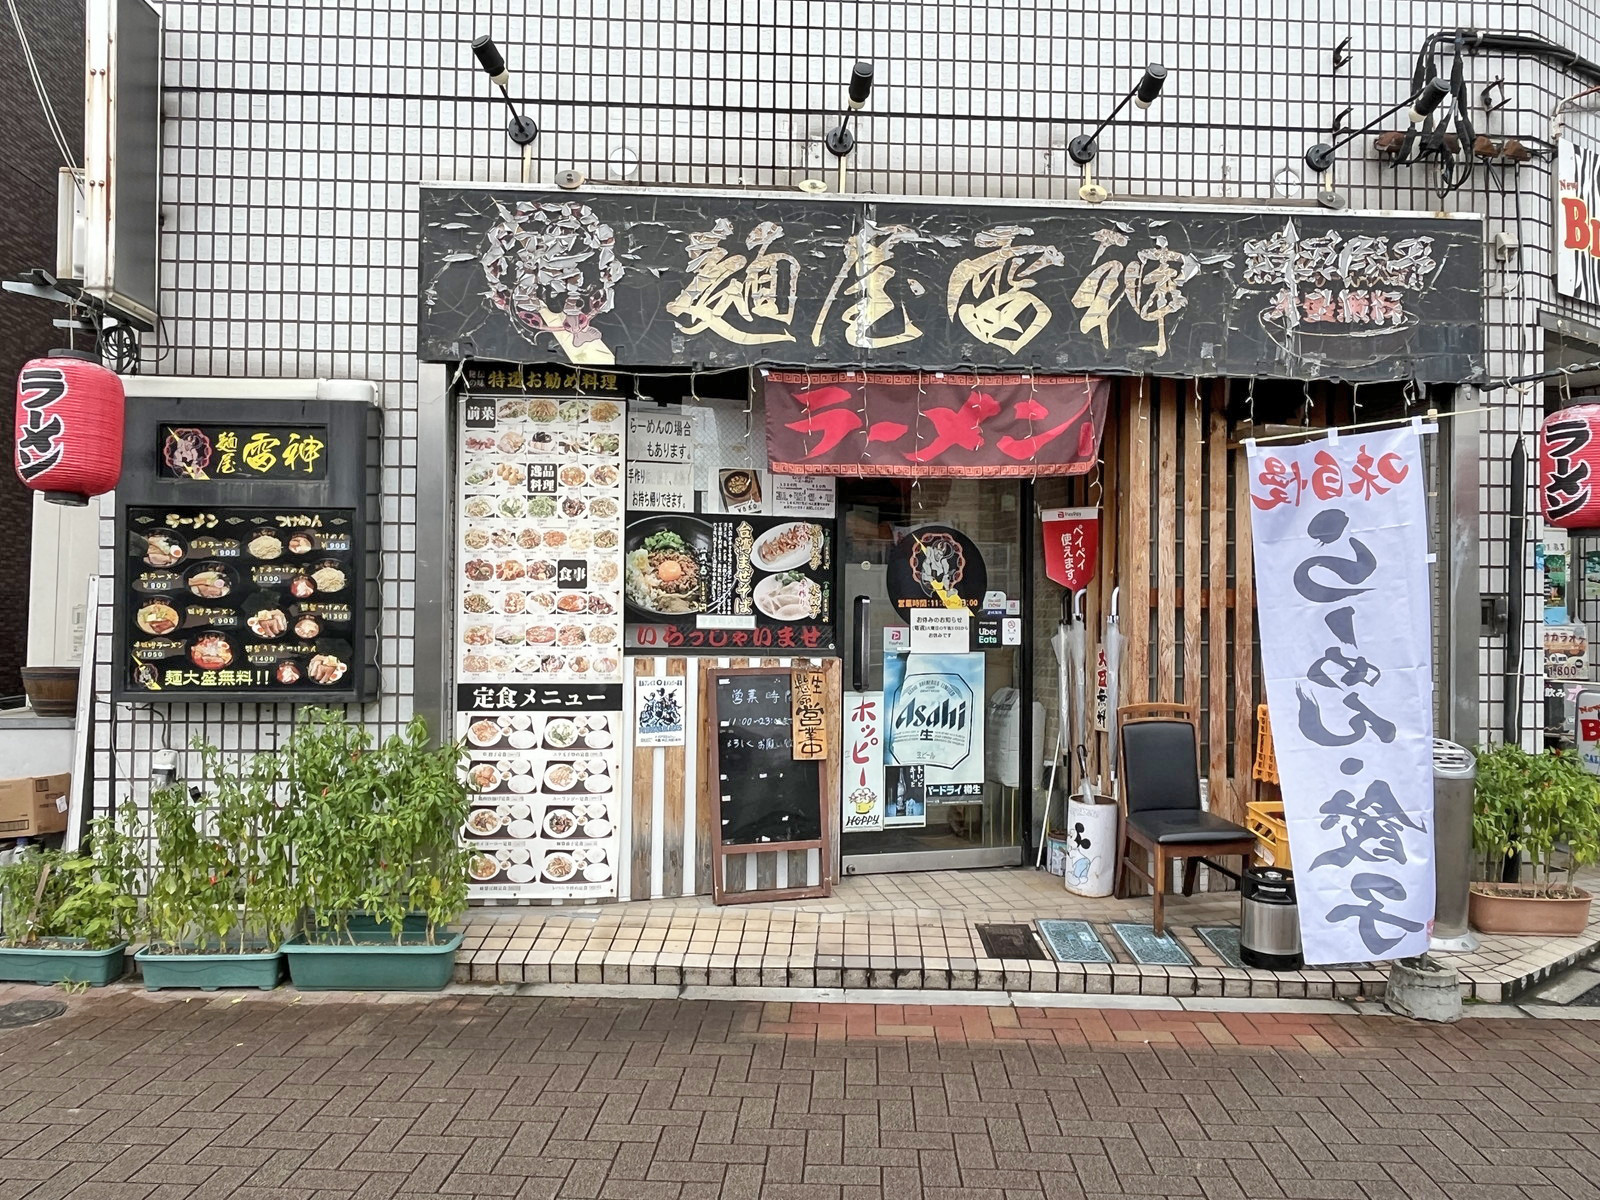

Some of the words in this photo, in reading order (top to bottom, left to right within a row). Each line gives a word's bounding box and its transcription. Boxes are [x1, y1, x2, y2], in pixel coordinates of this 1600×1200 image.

[1560, 180, 1578, 194] New
[487, 370, 619, 391] 特選お勧め料理
[467, 405, 495, 421] 前菜
[18, 369, 65, 482] ラーメン
[630, 417, 691, 437] らーめんの場合
[784, 385, 1092, 462] ラーメン
[215, 431, 242, 473] 麺屋
[243, 432, 324, 473] 雷神
[1545, 419, 1592, 521] ラーメン
[530, 478, 555, 492] 料理
[165, 513, 219, 529] ラーメン
[275, 514, 323, 528] つけめん
[1073, 524, 1086, 571] ペイペイ
[733, 520, 754, 615] 台湾まぜそば
[1061, 533, 1077, 585] 使えます。
[252, 575, 279, 583] ¥1000
[558, 566, 587, 582] 食事
[916, 616, 963, 624] お休みのお知らせ
[636, 625, 822, 648] いらっしゃいませ
[978, 627, 997, 636] Uber
[978, 636, 998, 644] Eats
[164, 670, 269, 686] 麺大盛無料!!
[472, 686, 607, 709] 定食メニュー
[895, 697, 967, 731] Asahi
[795, 702, 825, 757] 営業中
[919, 729, 934, 741] 生
[851, 697, 879, 787] ホッピー
[963, 784, 981, 795] 樽生
